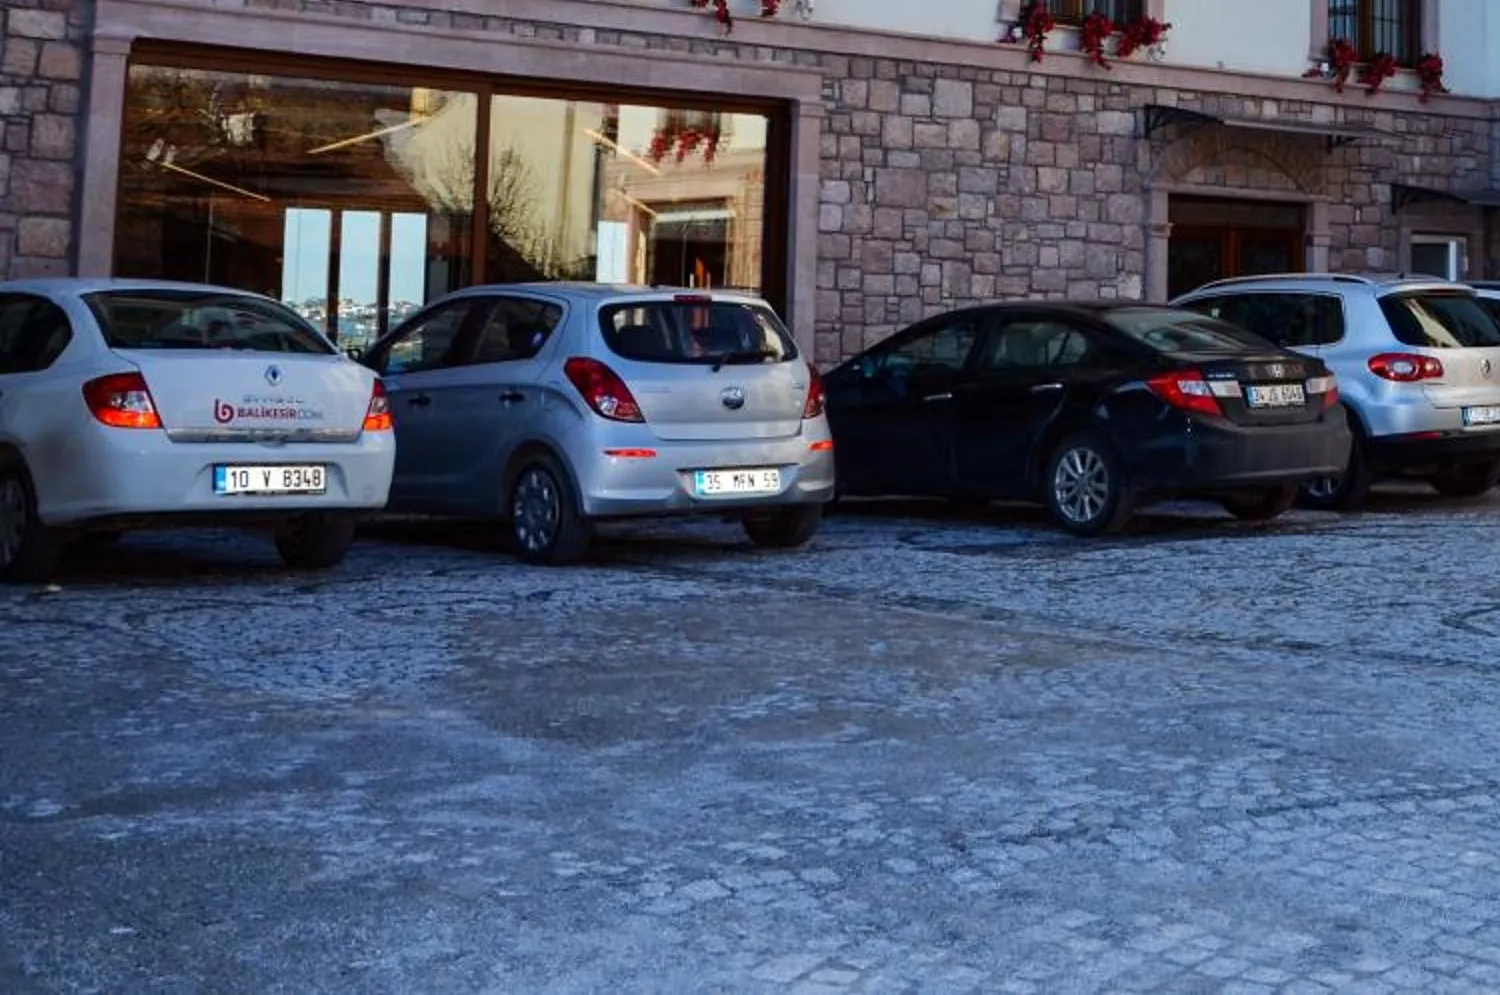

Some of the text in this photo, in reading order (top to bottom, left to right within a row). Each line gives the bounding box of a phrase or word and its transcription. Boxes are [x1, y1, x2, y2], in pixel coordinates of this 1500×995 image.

[230, 470, 249, 488] 10
[262, 469, 272, 488] V
[706, 474, 721, 490] 35
